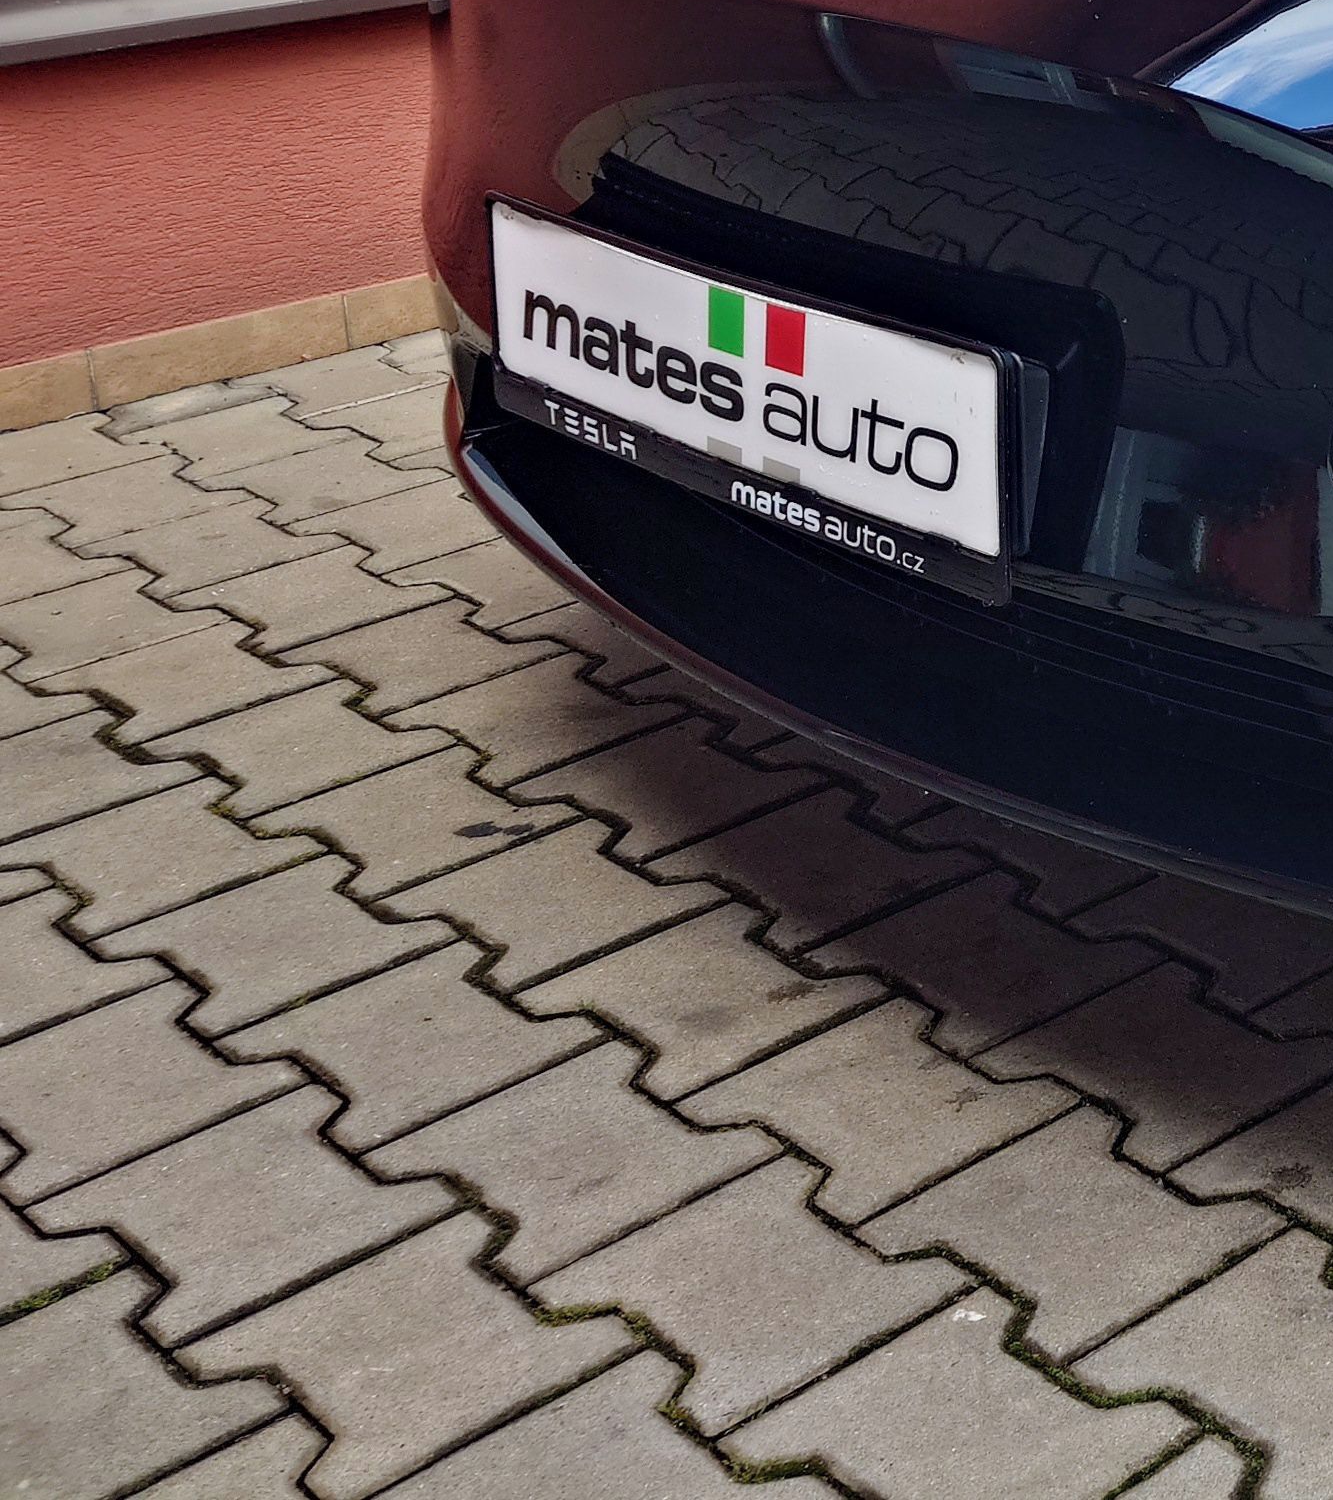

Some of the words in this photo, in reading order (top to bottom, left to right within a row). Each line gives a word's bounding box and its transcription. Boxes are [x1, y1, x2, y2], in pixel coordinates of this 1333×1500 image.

[523, 287, 745, 422] mates
[762, 381, 960, 492] auto
[544, 399, 638, 462] TESLA
